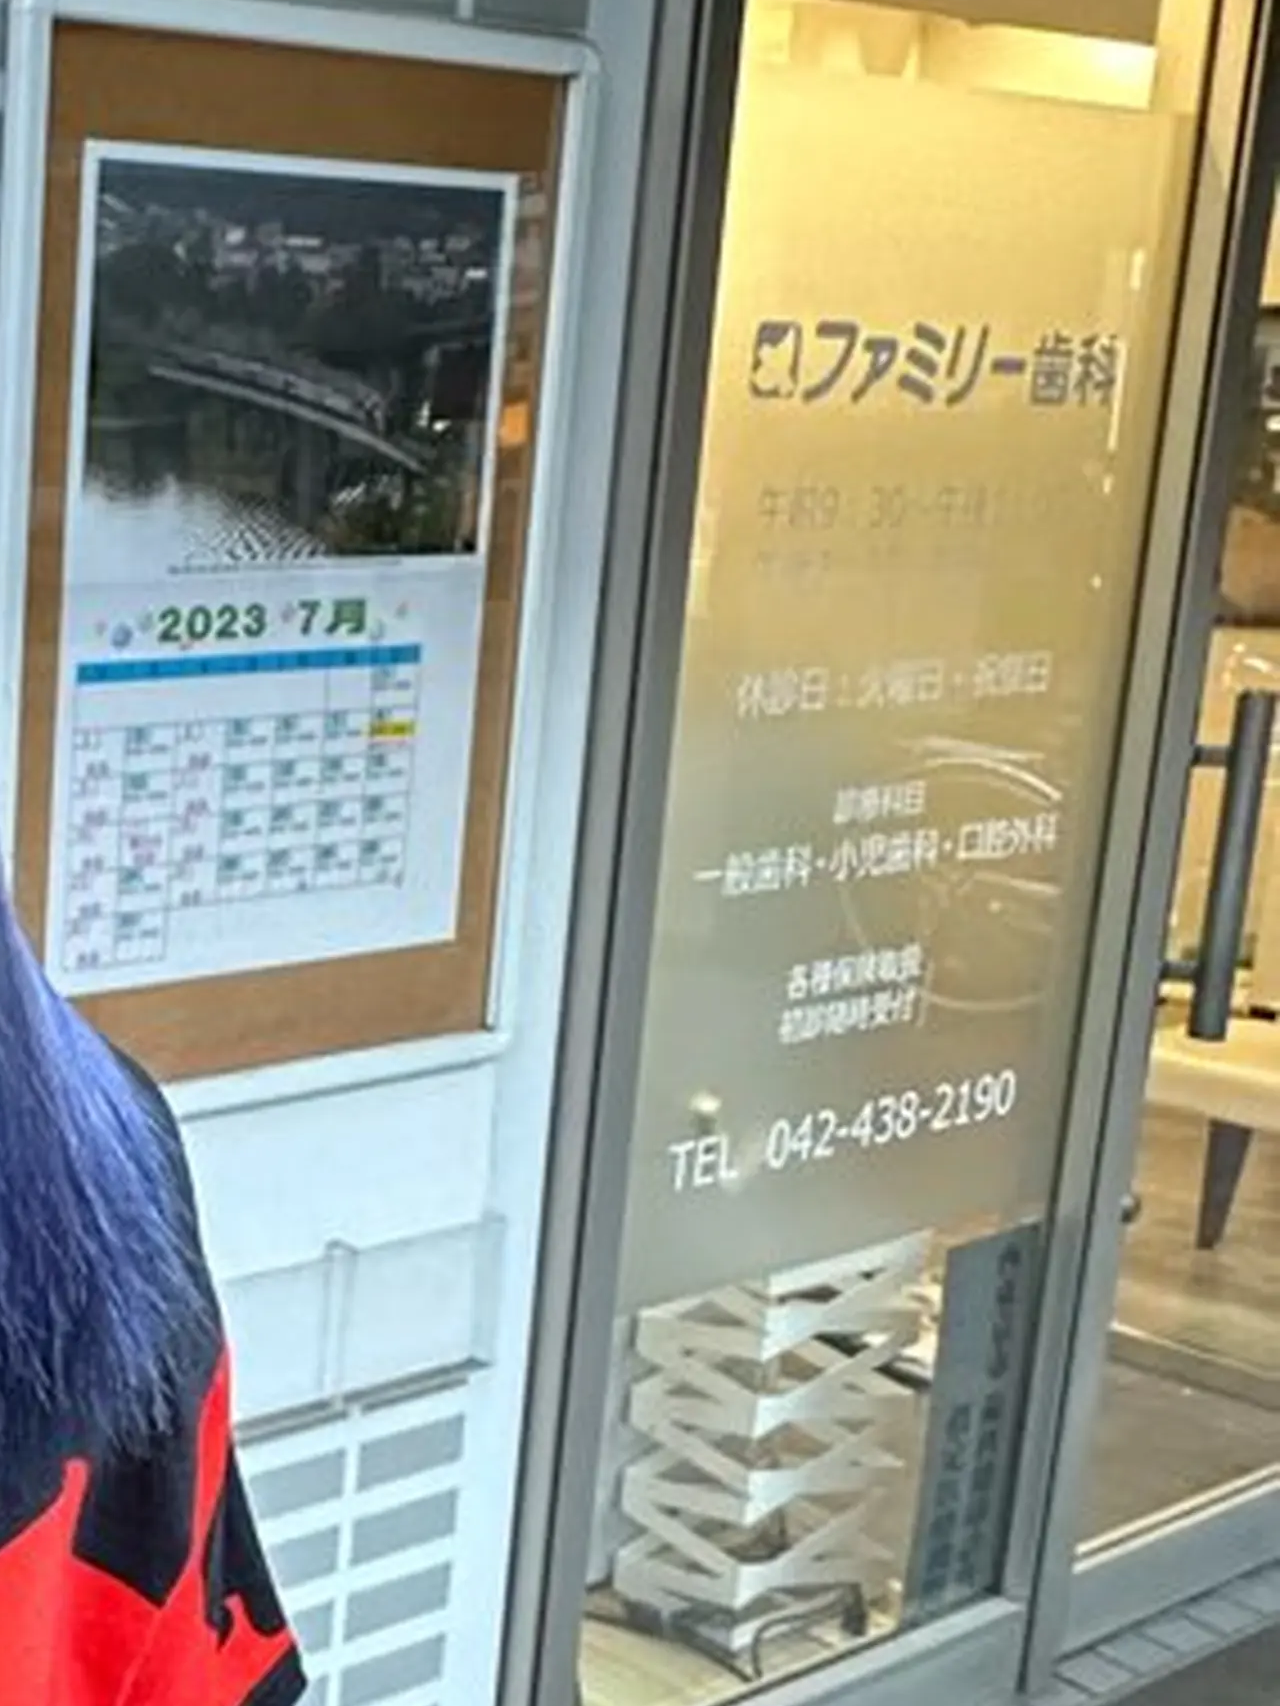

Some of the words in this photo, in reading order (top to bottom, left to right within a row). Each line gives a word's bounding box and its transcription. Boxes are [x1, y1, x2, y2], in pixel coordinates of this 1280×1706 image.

[801, 319, 1121, 407] ファミリー歯科
[157, 603, 269, 643] 2023
[297, 597, 367, 637] 7月
[668, 1134, 740, 1192] TEL
[765, 1069, 1017, 1170] 042-438-2190
